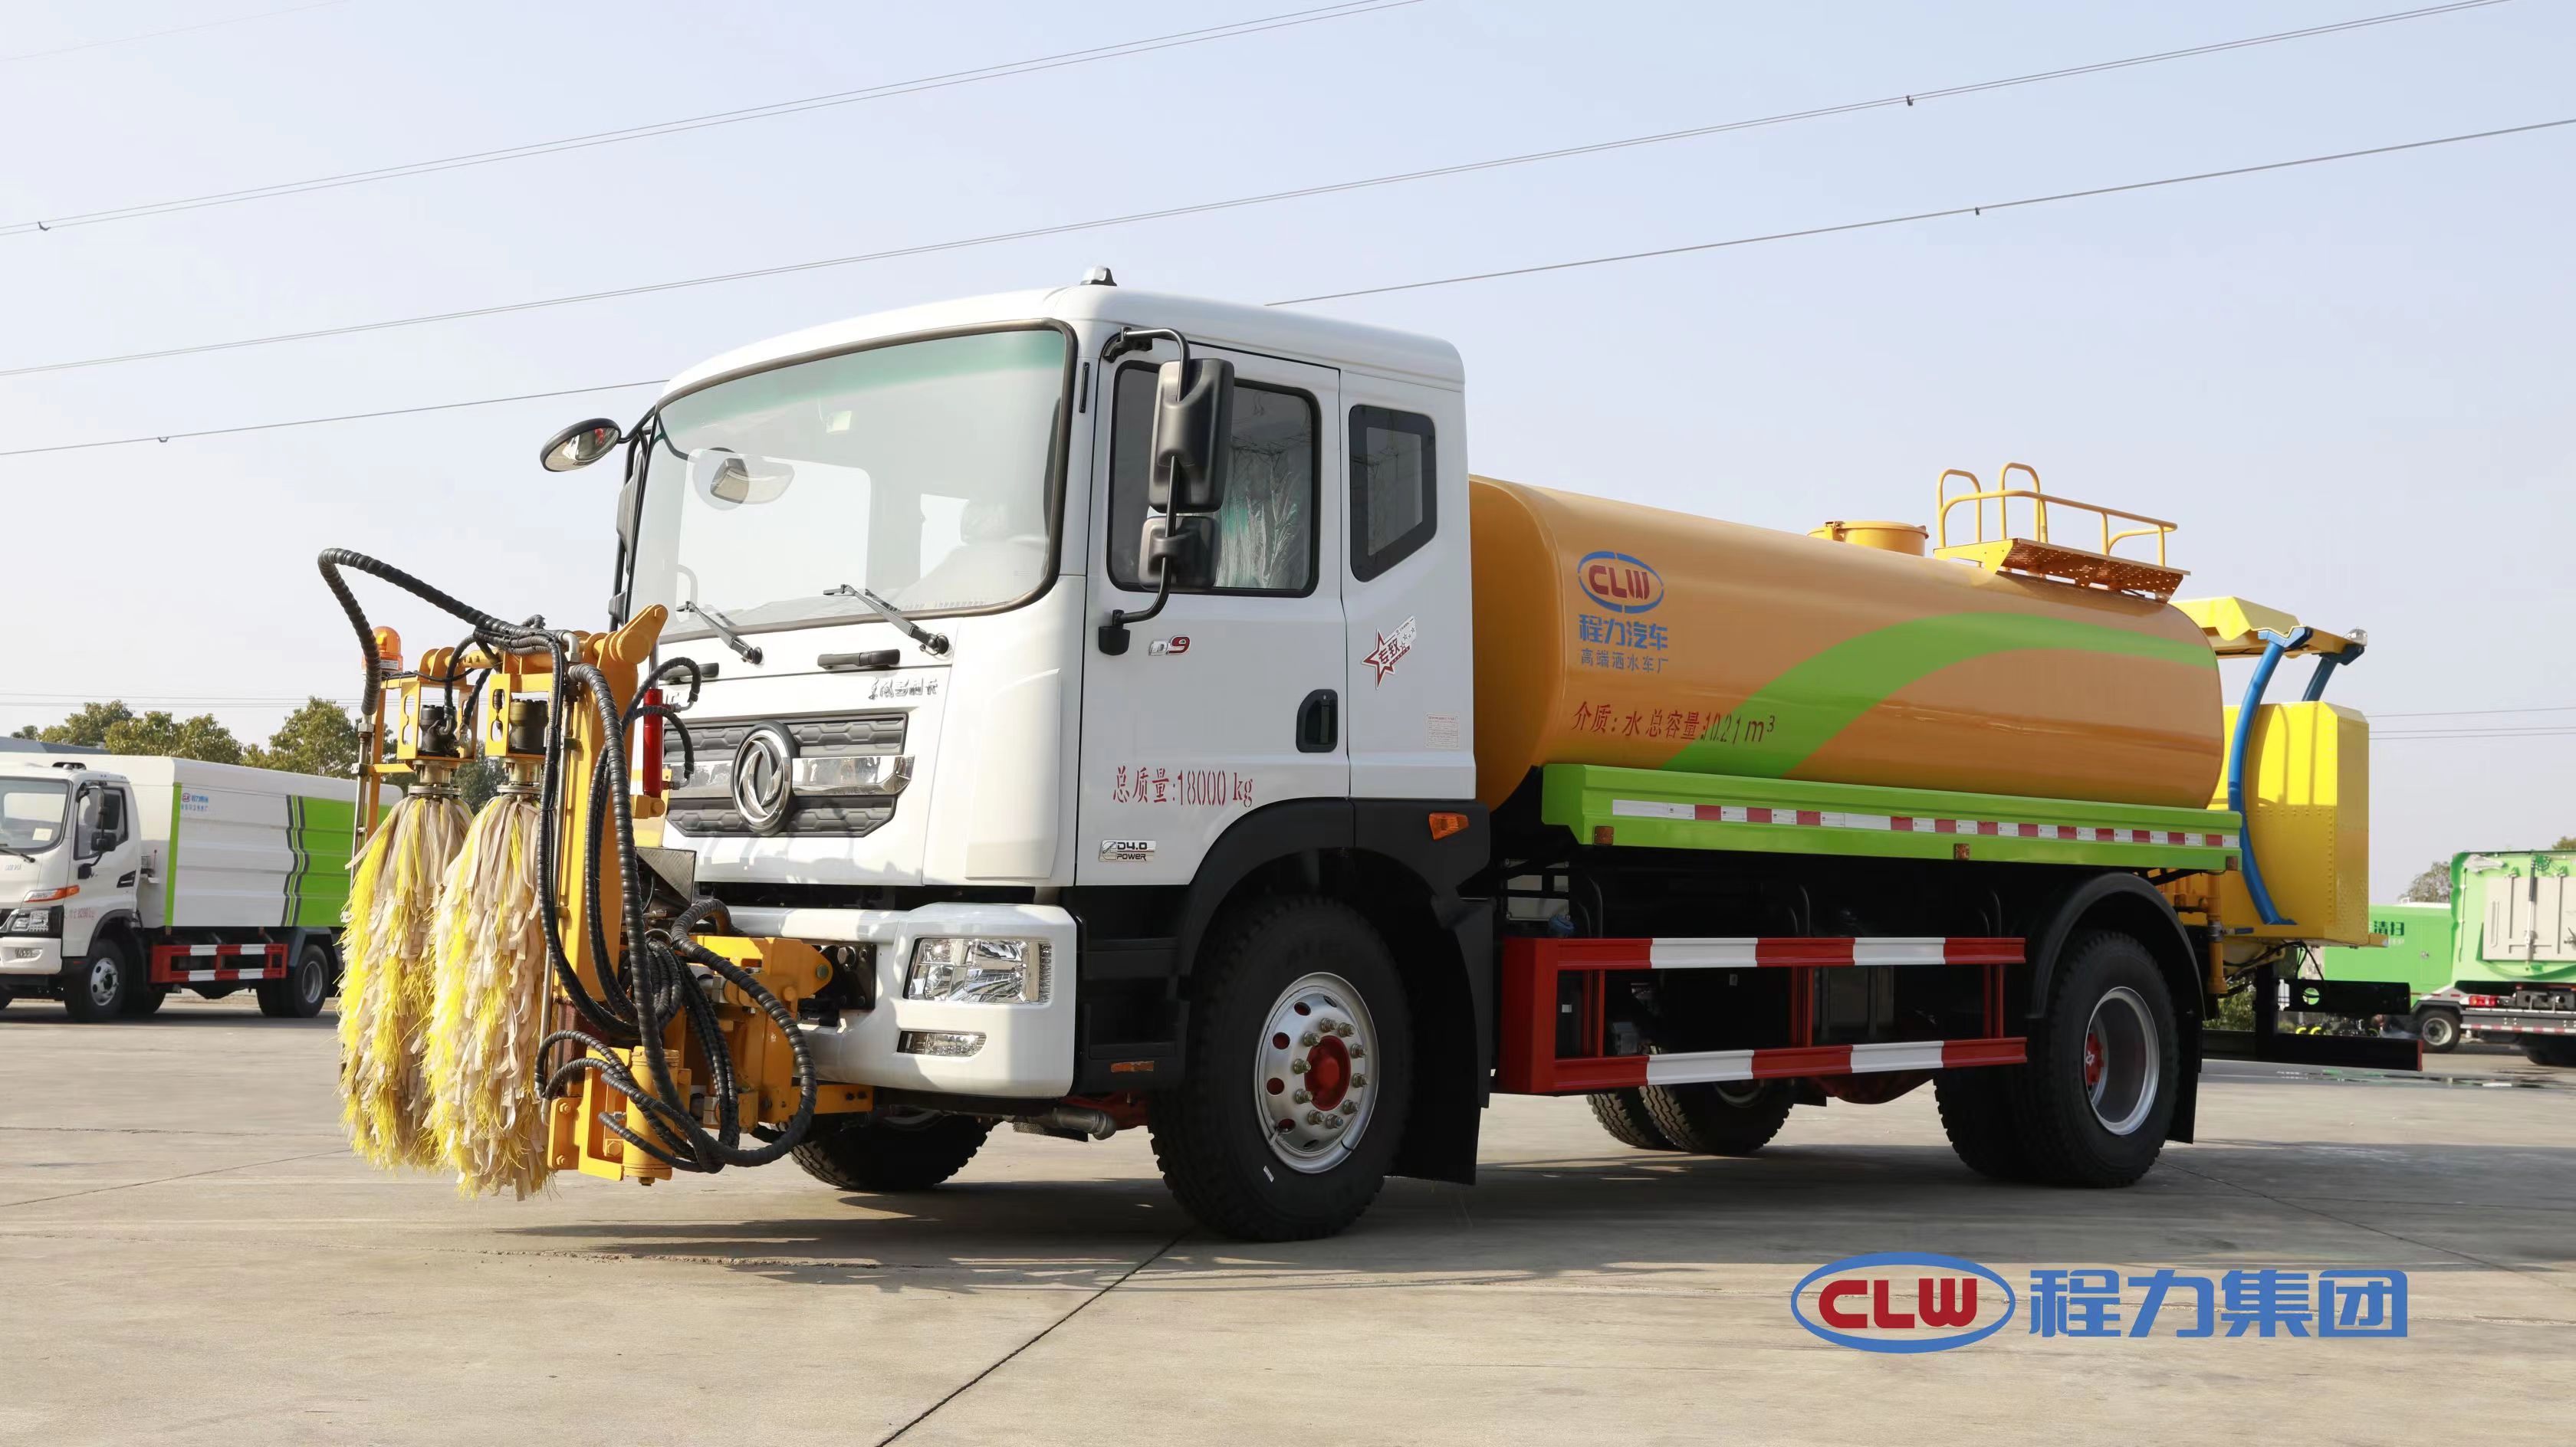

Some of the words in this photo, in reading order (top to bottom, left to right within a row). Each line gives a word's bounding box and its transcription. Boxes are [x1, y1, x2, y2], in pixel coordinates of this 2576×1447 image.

[1589, 565, 1650, 600] CLW
[1579, 614, 1668, 651] 程力汽车
[1148, 635, 1191, 656] D9
[1582, 648, 1669, 674] 高端洒水车厂
[1116, 853, 1147, 861] POWER
[1117, 842, 1148, 851] D4.0
